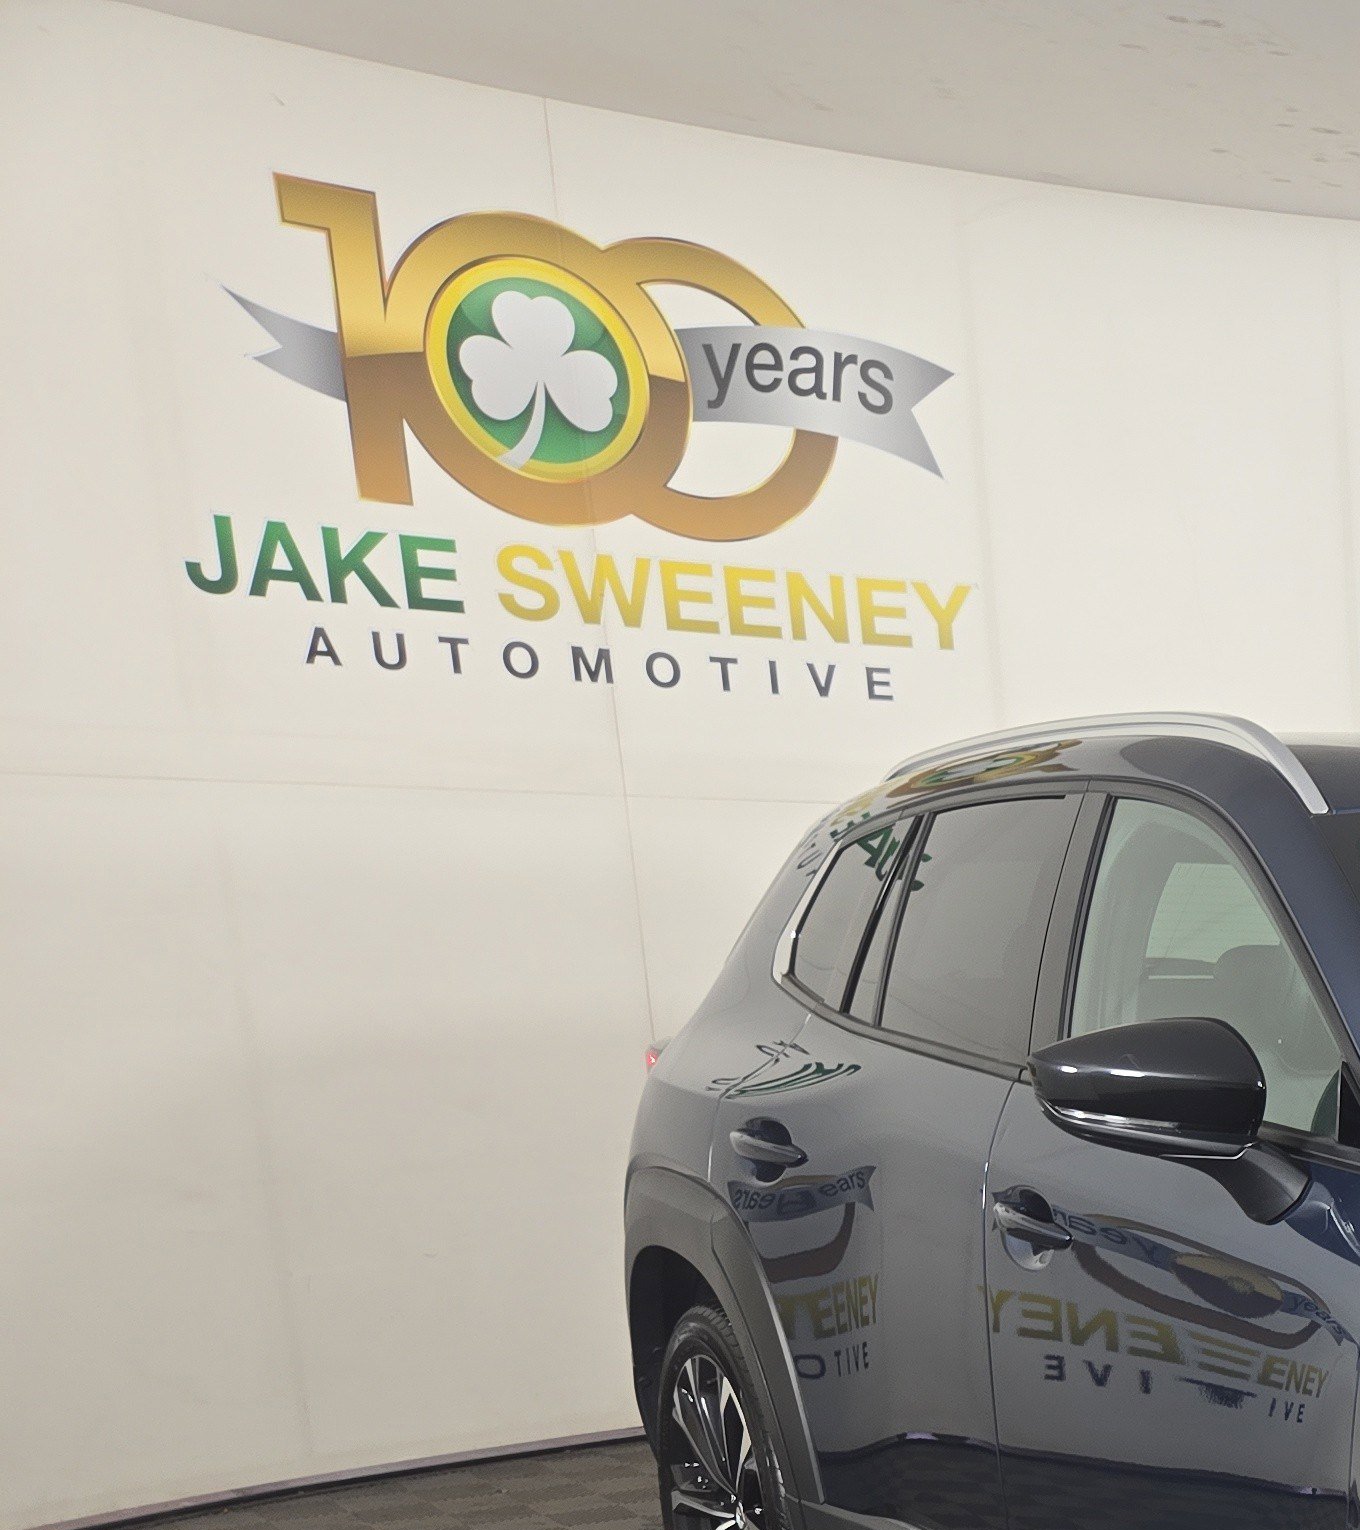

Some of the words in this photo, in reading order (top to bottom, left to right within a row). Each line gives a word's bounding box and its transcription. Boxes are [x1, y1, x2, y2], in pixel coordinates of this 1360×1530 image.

[703, 340, 895, 415] years
[185, 514, 465, 614] JAKE
[495, 543, 972, 651] SWEENEY
[305, 626, 895, 701] AUTOMOTIVE
